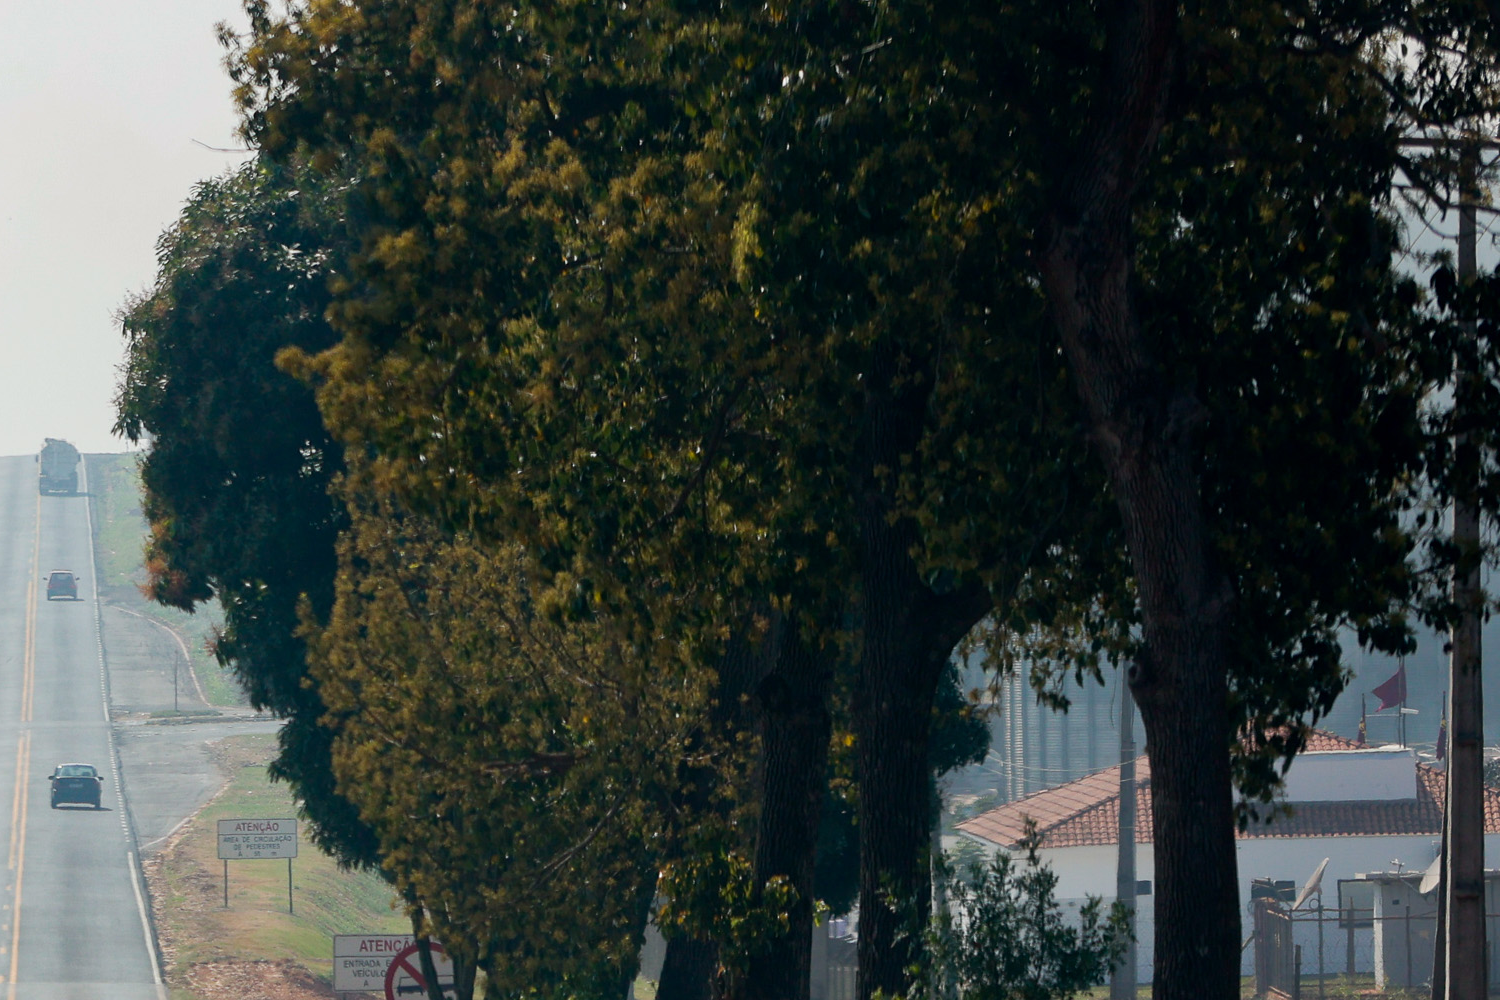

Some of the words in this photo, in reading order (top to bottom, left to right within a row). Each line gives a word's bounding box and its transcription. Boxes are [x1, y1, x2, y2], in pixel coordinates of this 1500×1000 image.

[235, 821, 279, 834] ATENÇÃO
[254, 835, 292, 843] CIRCULAÇÃO
[359, 937, 416, 953] ATENÇÃ
[343, 960, 380, 968] ENTRADA
[352, 968, 388, 977] VEÍCULO
